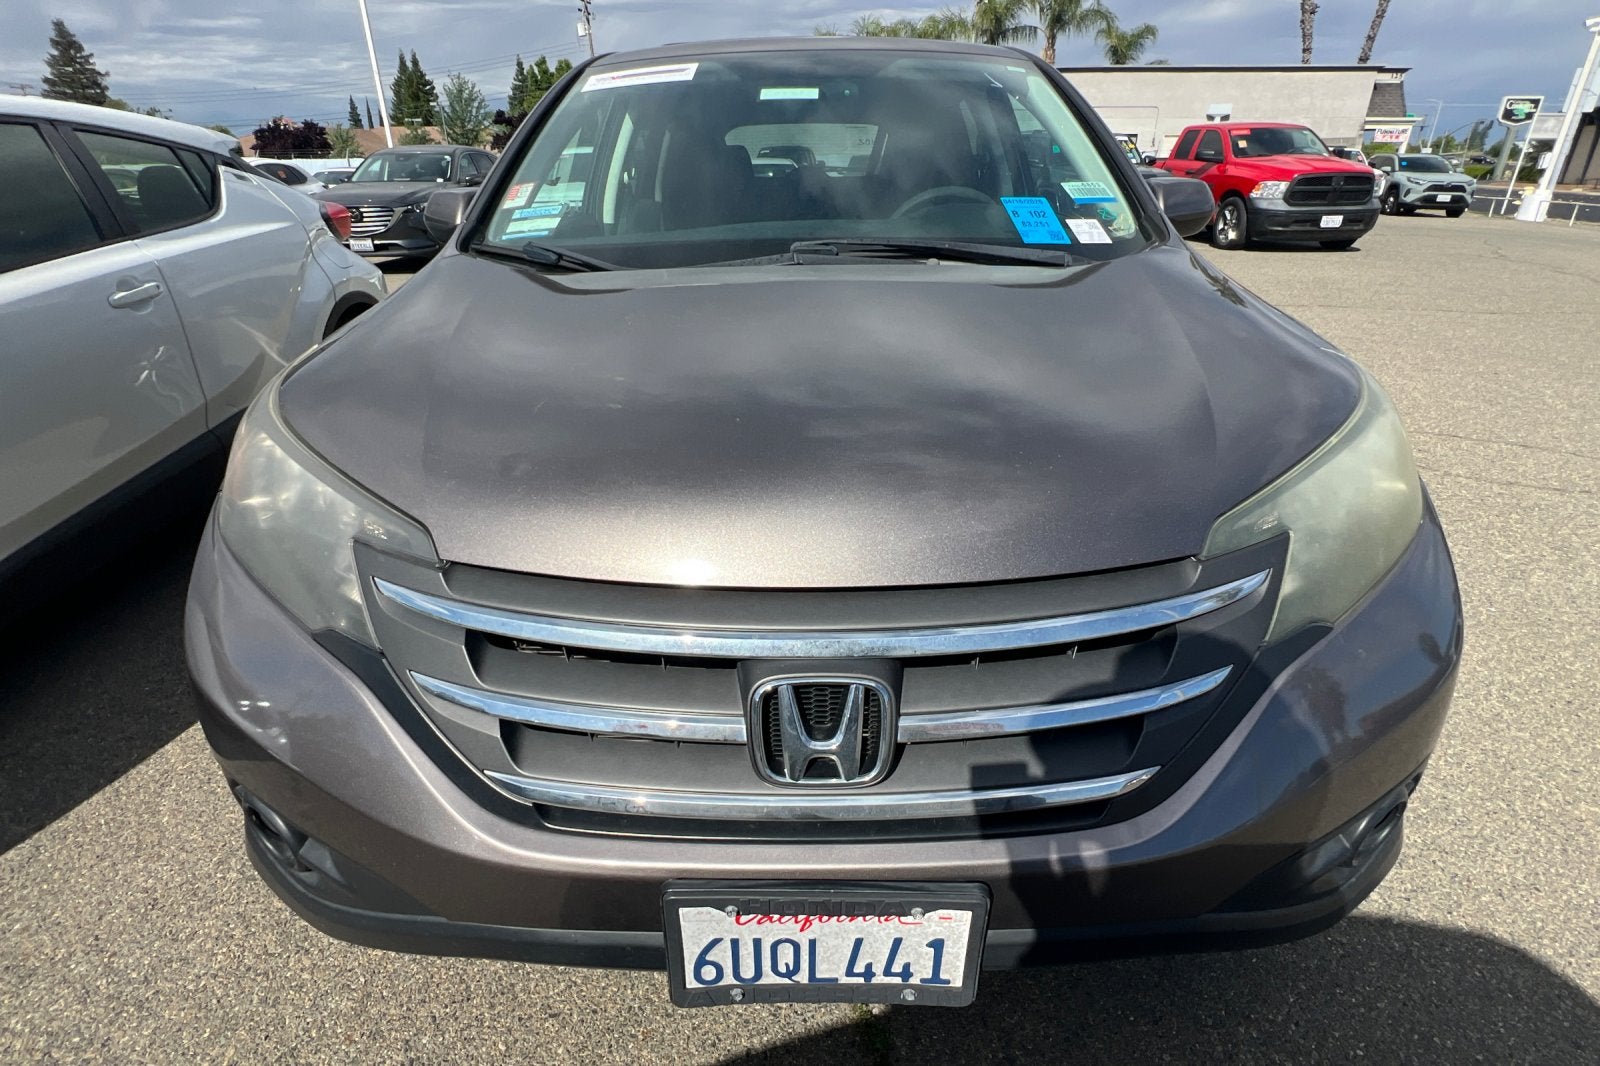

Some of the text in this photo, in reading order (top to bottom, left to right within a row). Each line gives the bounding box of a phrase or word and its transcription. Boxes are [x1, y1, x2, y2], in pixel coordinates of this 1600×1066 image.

[1011, 210, 1048, 219] B 102
[739, 898, 910, 917] HONDA
[692, 936, 952, 986] 6UQL441
